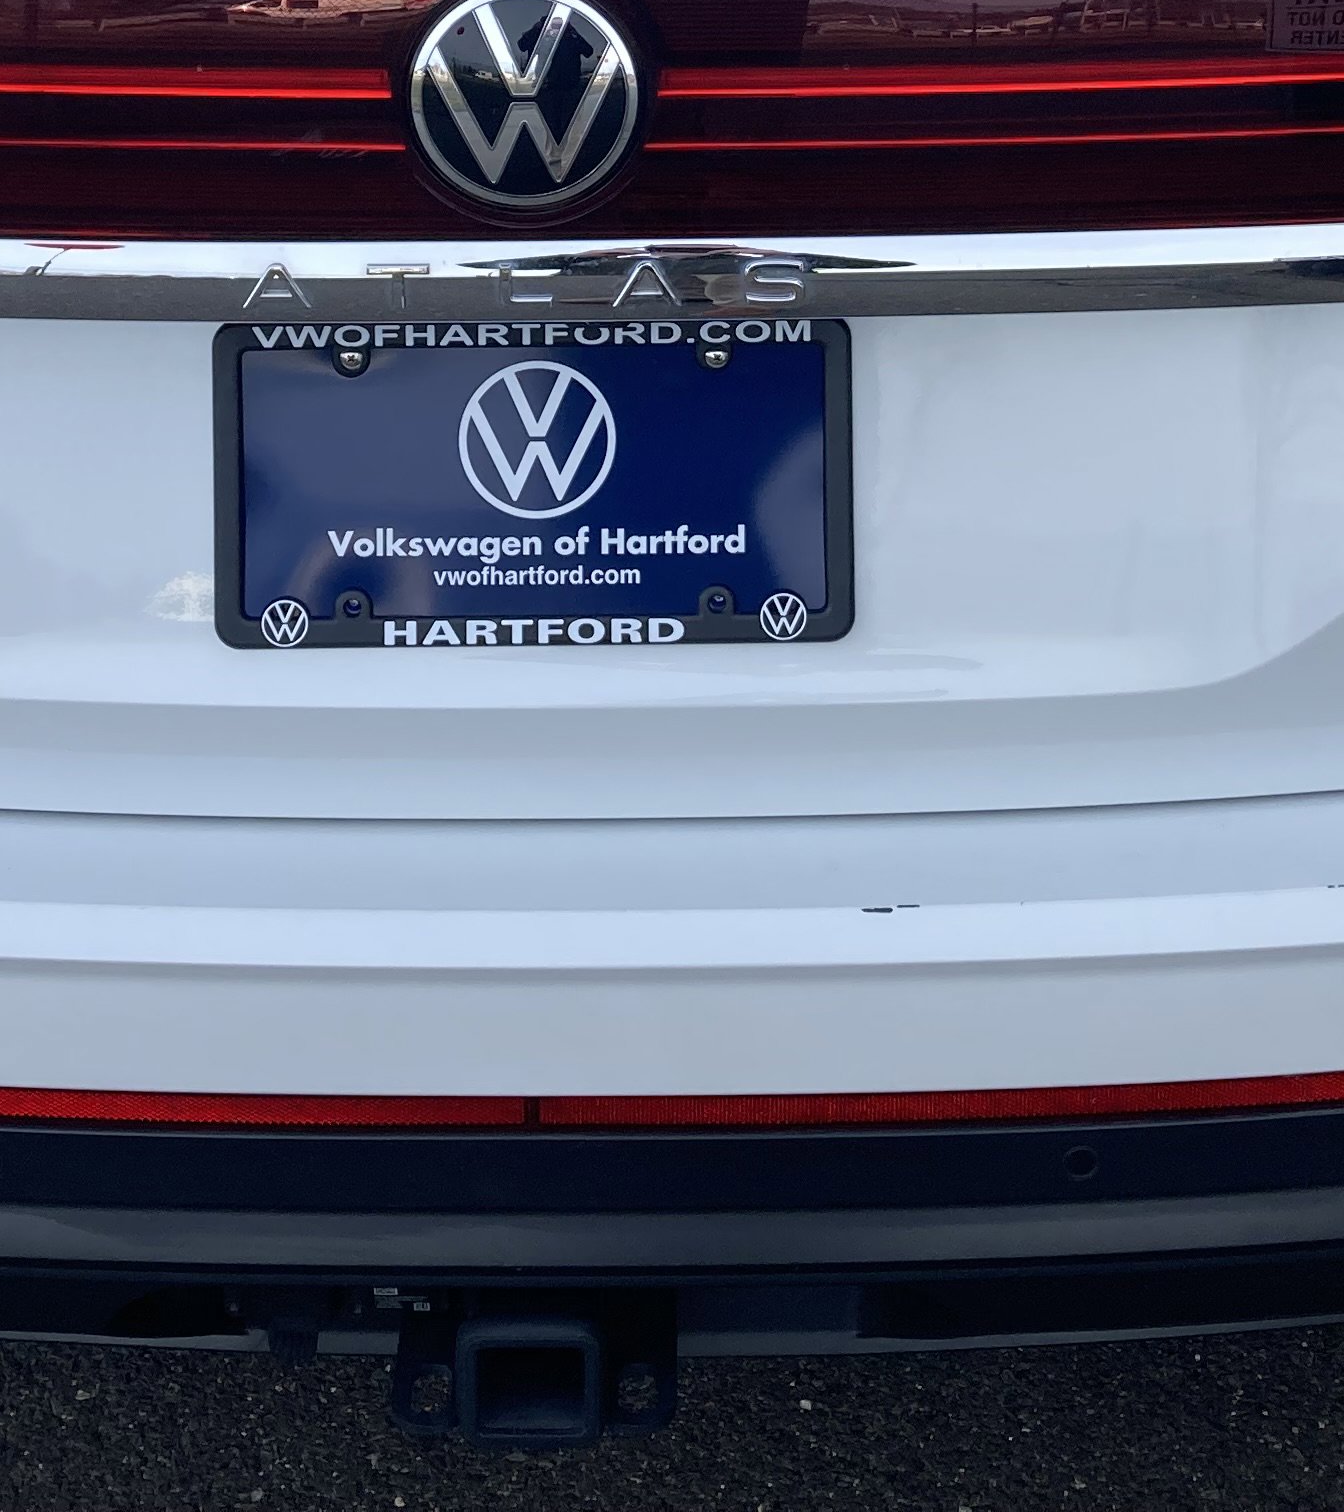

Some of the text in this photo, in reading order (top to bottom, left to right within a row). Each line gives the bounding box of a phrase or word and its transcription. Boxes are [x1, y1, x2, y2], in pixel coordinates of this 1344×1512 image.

[243, 259, 805, 309] ATLAS
[251, 320, 812, 349] VWOFHARTFORD.COM
[462, 364, 613, 514] VW
[327, 524, 747, 565] Volkswagen of Hartford
[433, 565, 642, 587] vwofhartford.com
[262, 601, 308, 647] VW
[383, 617, 686, 647] HARTFORD
[761, 594, 807, 640] VW
